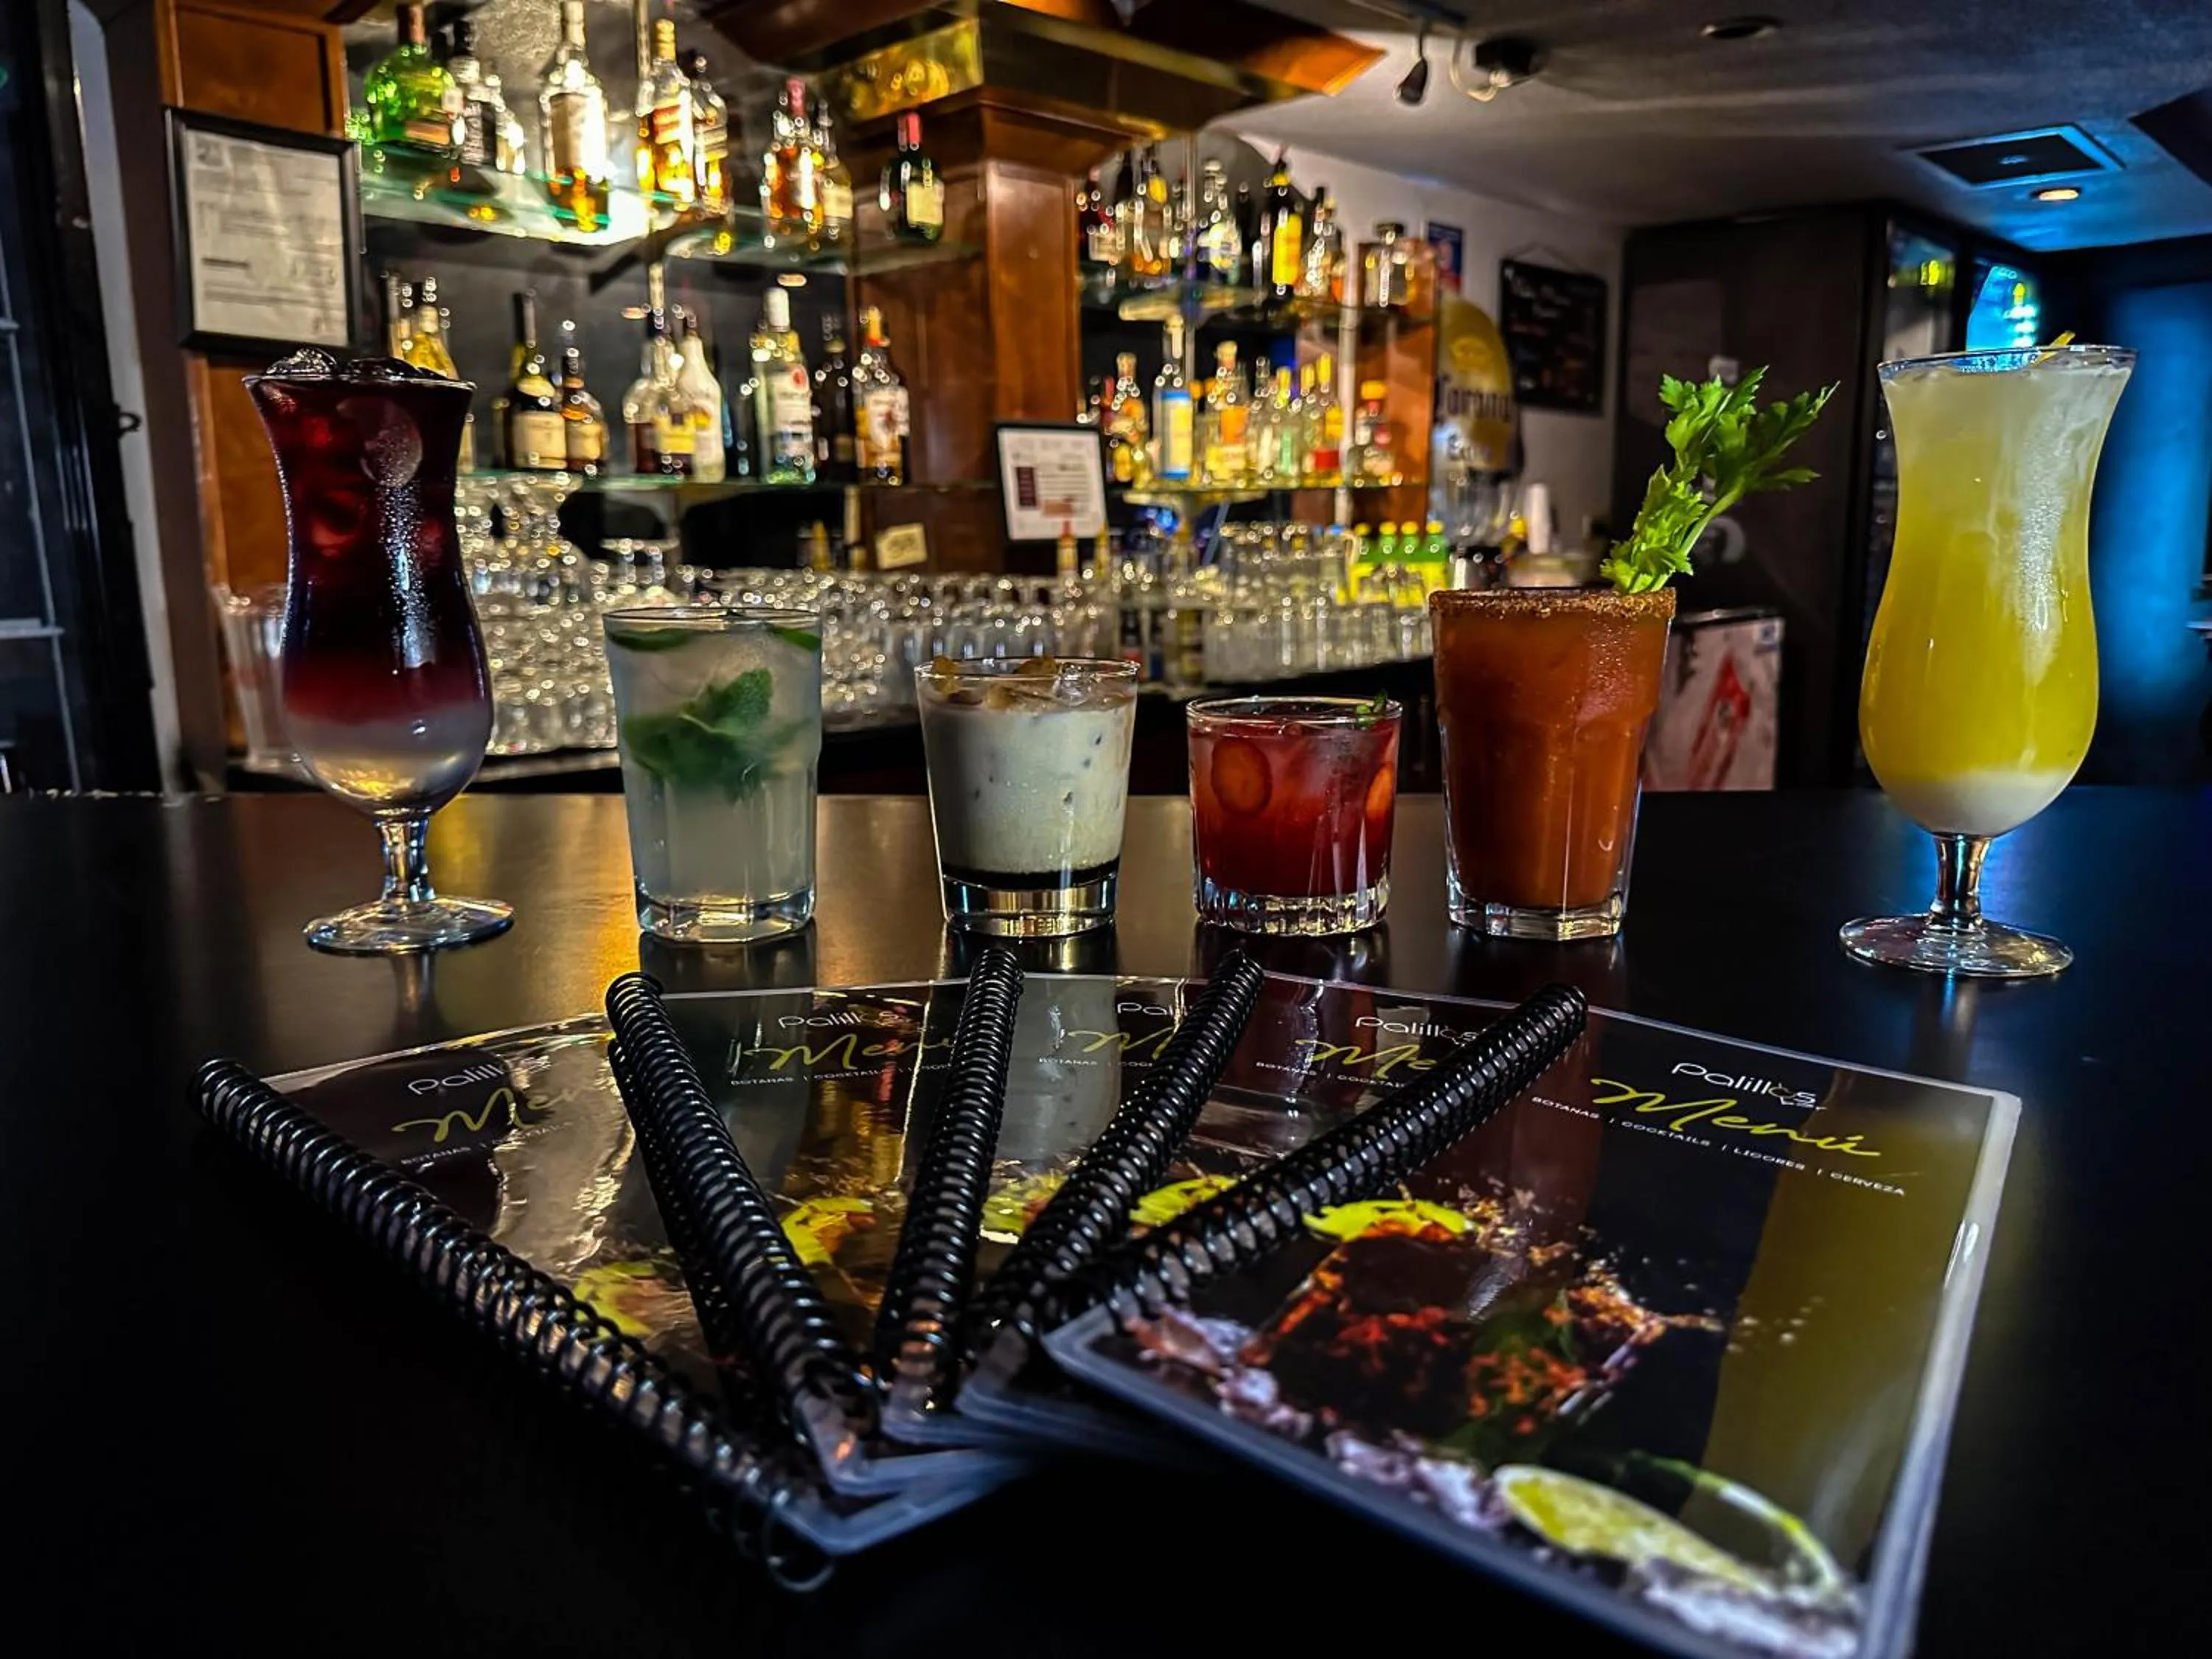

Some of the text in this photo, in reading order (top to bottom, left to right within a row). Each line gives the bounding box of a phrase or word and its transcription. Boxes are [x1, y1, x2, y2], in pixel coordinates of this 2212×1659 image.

[408, 1064, 505, 1095] Palill
[1672, 1062, 1818, 1105] Palillos
[1531, 1096, 1600, 1119] BOTANAS
[1621, 1120, 1711, 1147] COCKTAILS
[1829, 1171, 1905, 1197] CERVEZA
[1590, 1079, 1881, 1156] Menú
